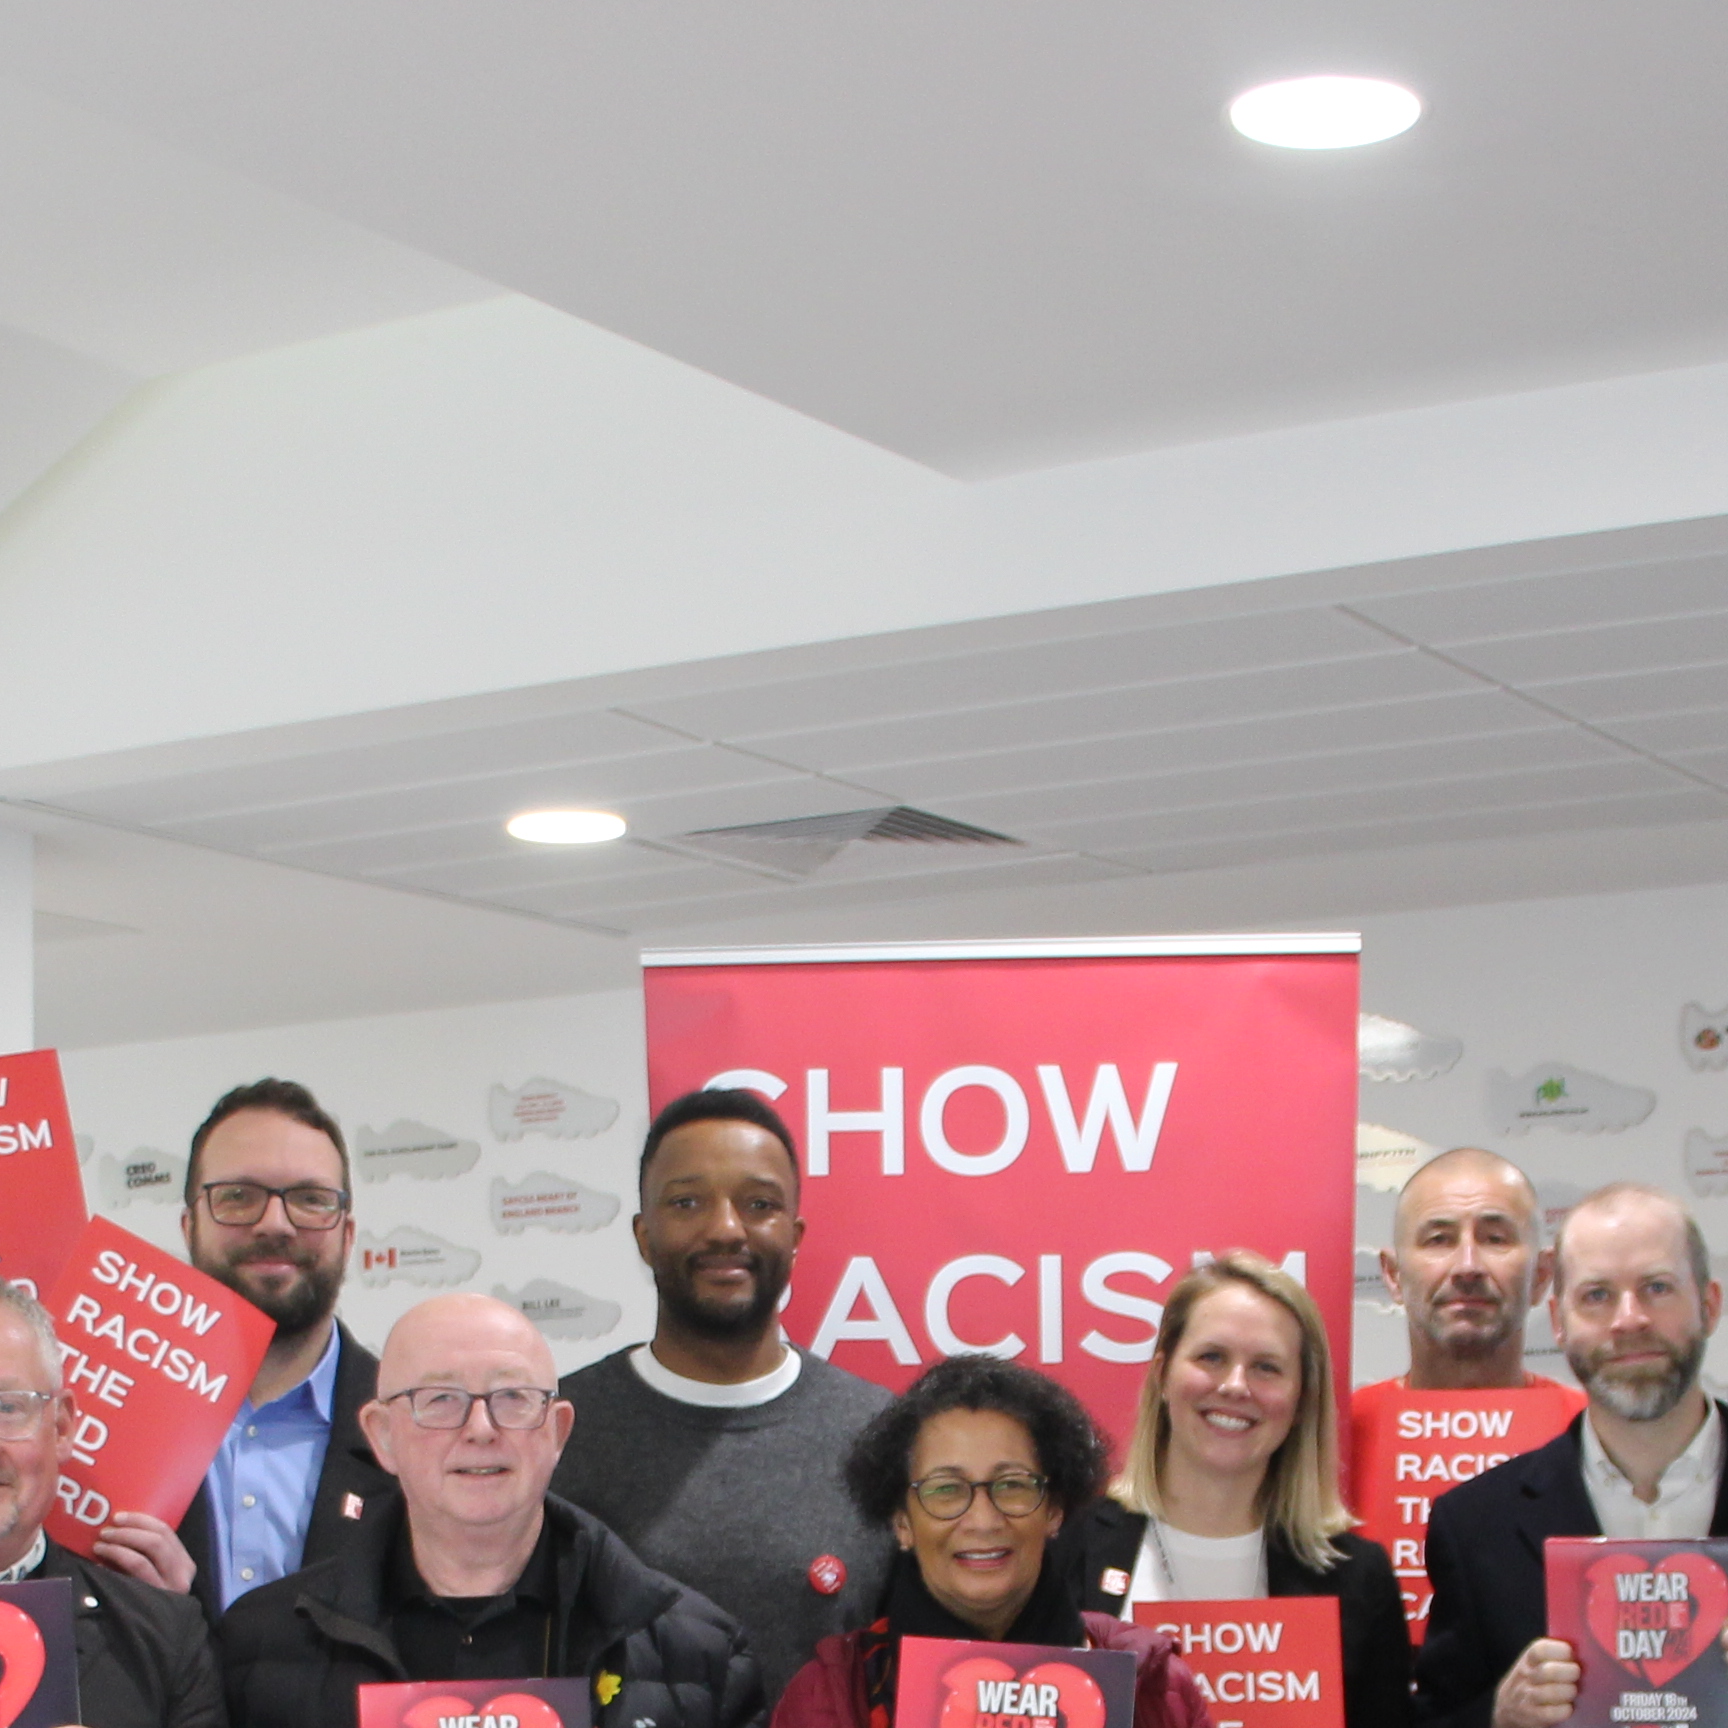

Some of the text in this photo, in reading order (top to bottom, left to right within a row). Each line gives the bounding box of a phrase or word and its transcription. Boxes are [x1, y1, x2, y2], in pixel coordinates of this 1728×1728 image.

[702, 1062, 1178, 1178] HOW
[92, 1248, 222, 1338] SHOW
[777, 1251, 1307, 1365] ACIS
[67, 1293, 230, 1405] RACISM
[57, 1341, 135, 1408] THE
[1397, 1410, 1513, 1439] SHOW
[1396, 1453, 1520, 1482] RACI
[56, 1474, 110, 1526] RD
[1616, 1572, 1690, 1602] WEAR
[1618, 1602, 1668, 1629] RED
[1618, 1630, 1666, 1660] DAY
[978, 1679, 1060, 1717] WEAR
[1193, 1670, 1321, 1703] ACISM
[1620, 1692, 1663, 1707] FRIDAY
[1611, 1706, 1697, 1721] OCTOBER 2024
